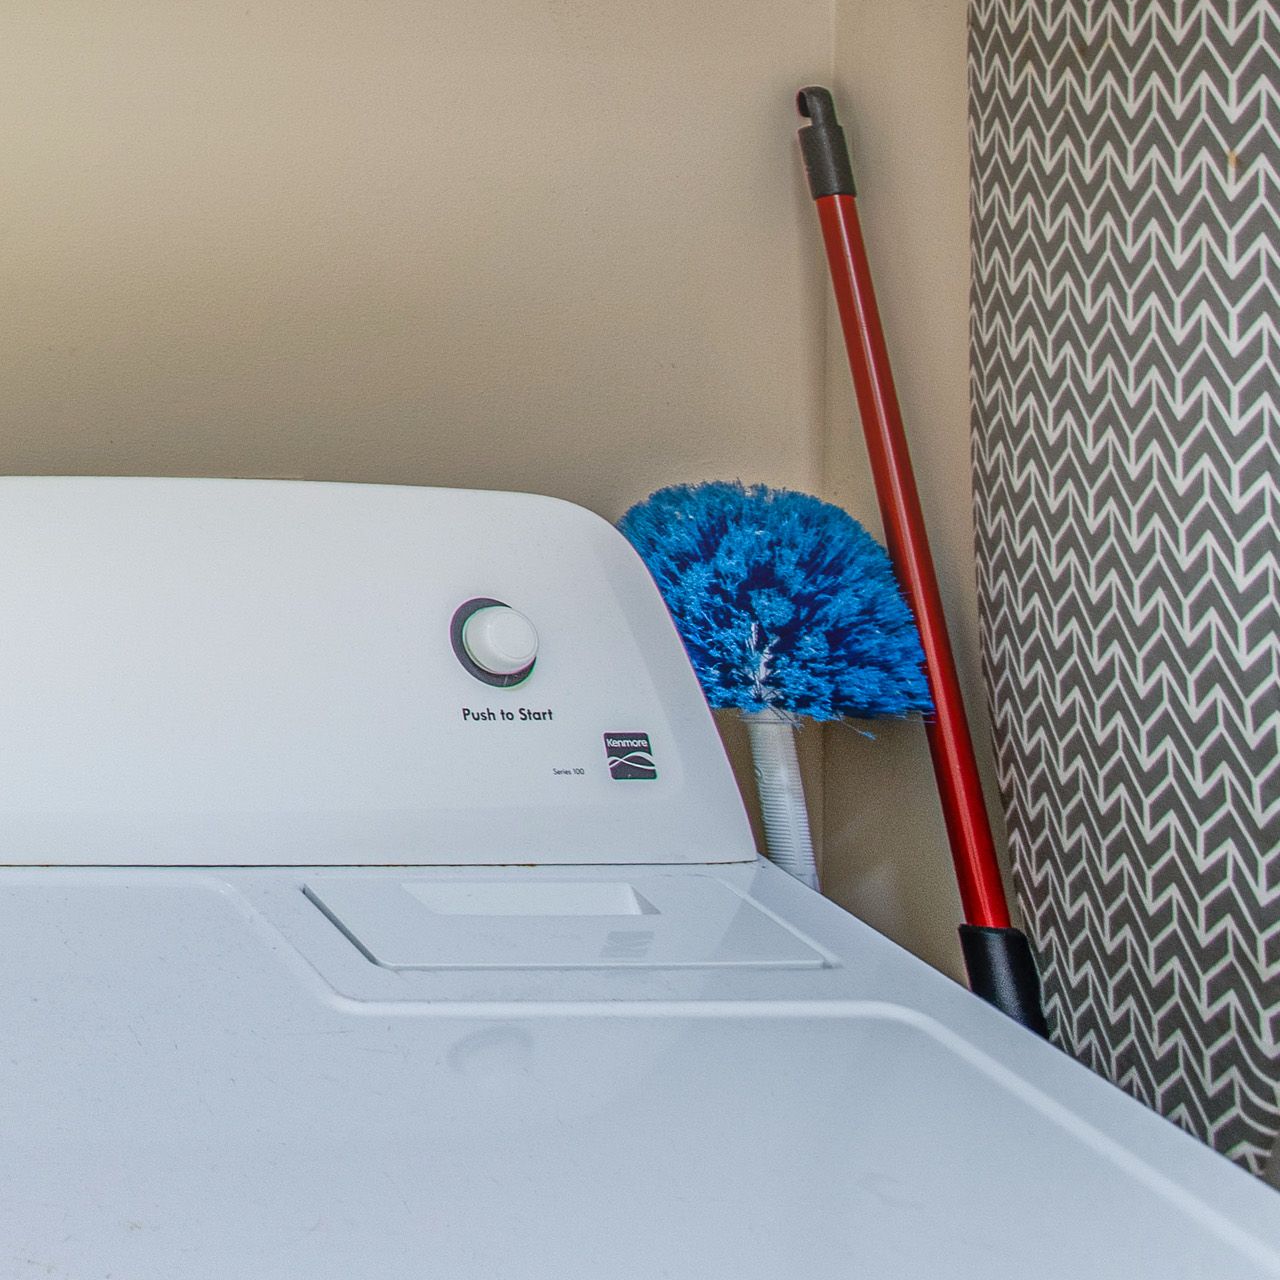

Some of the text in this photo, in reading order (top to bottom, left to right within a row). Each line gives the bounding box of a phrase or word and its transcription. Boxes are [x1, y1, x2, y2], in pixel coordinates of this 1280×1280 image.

[461, 707, 554, 722] Push to Start
[606, 737, 649, 749] Kenmore
[552, 767, 585, 776] Series 100
